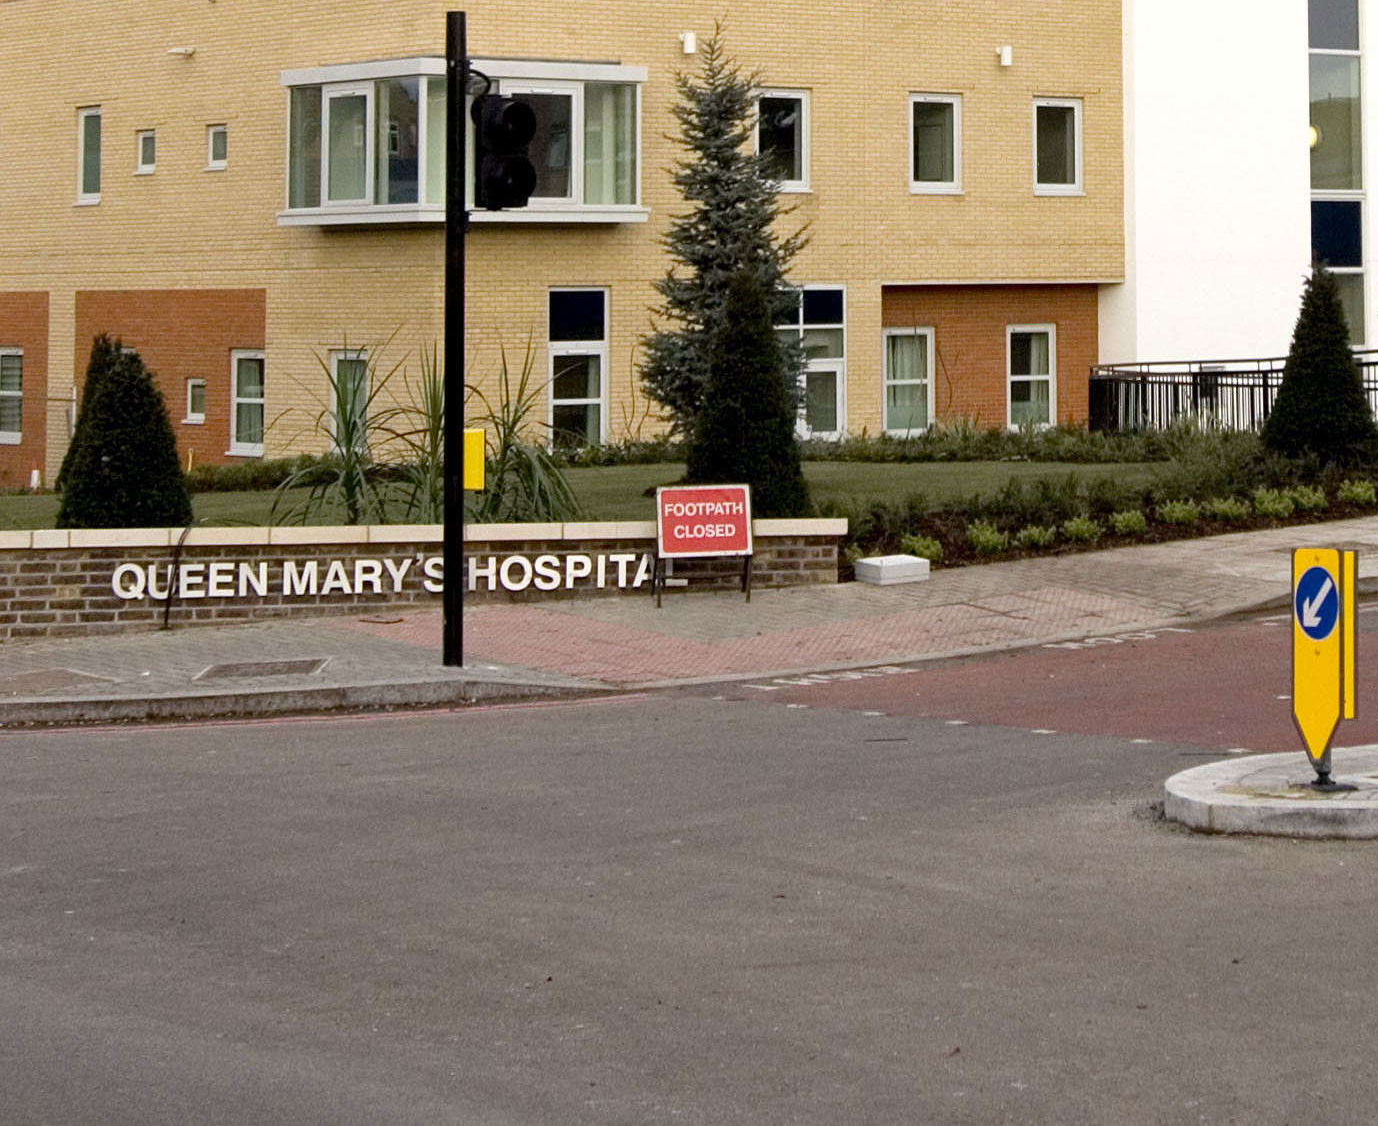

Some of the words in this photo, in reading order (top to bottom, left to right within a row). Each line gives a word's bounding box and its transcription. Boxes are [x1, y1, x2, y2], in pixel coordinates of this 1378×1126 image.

[664, 502, 743, 517] FOOTPATH
[674, 524, 735, 539] CLOSED
[111, 562, 268, 600] QUEEN
[283, 553, 444, 595] MARY'S
[468, 554, 688, 591] HOSPITAL
